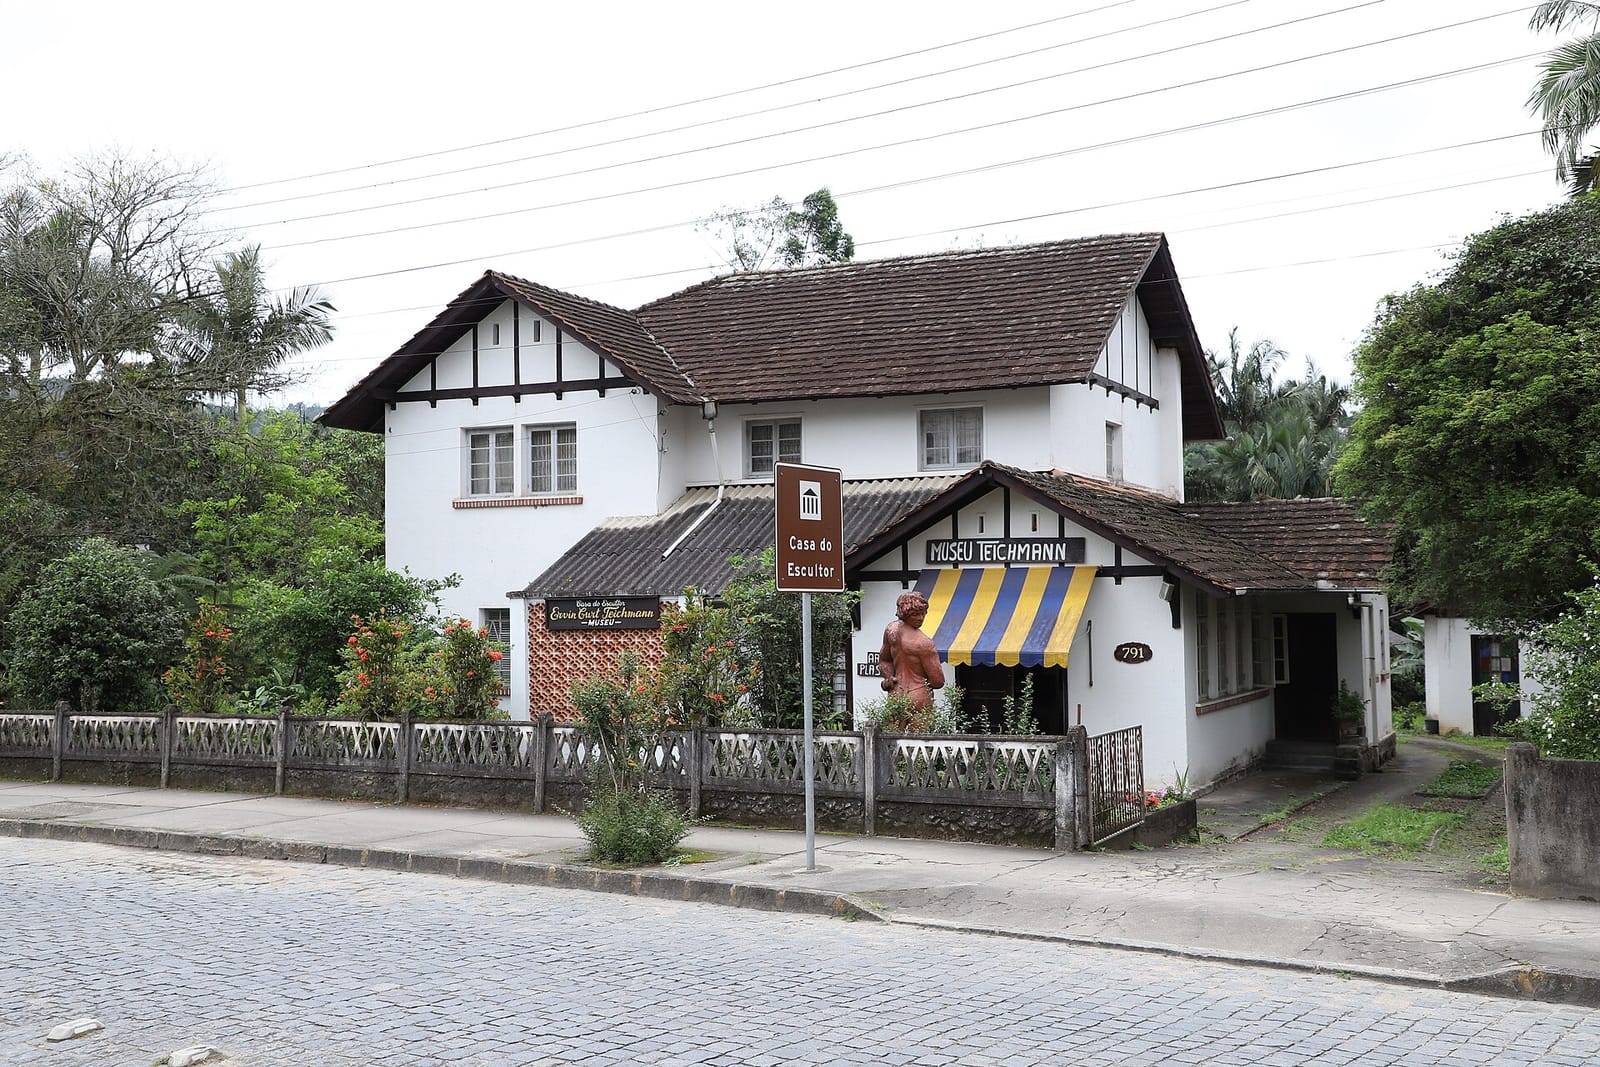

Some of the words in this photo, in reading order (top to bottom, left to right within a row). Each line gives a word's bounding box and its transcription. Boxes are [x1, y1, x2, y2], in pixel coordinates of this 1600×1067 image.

[789, 535, 816, 551] Casa
[820, 537, 832, 552] do
[930, 540, 973, 562] MUSEU
[976, 540, 1067, 562] TEICHMANN
[787, 562, 835, 578] Escultor
[578, 607, 600, 619] Curt
[602, 606, 654, 620] Teichmann
[1122, 647, 1144, 658] 791
[860, 664, 880, 675] PLAS
